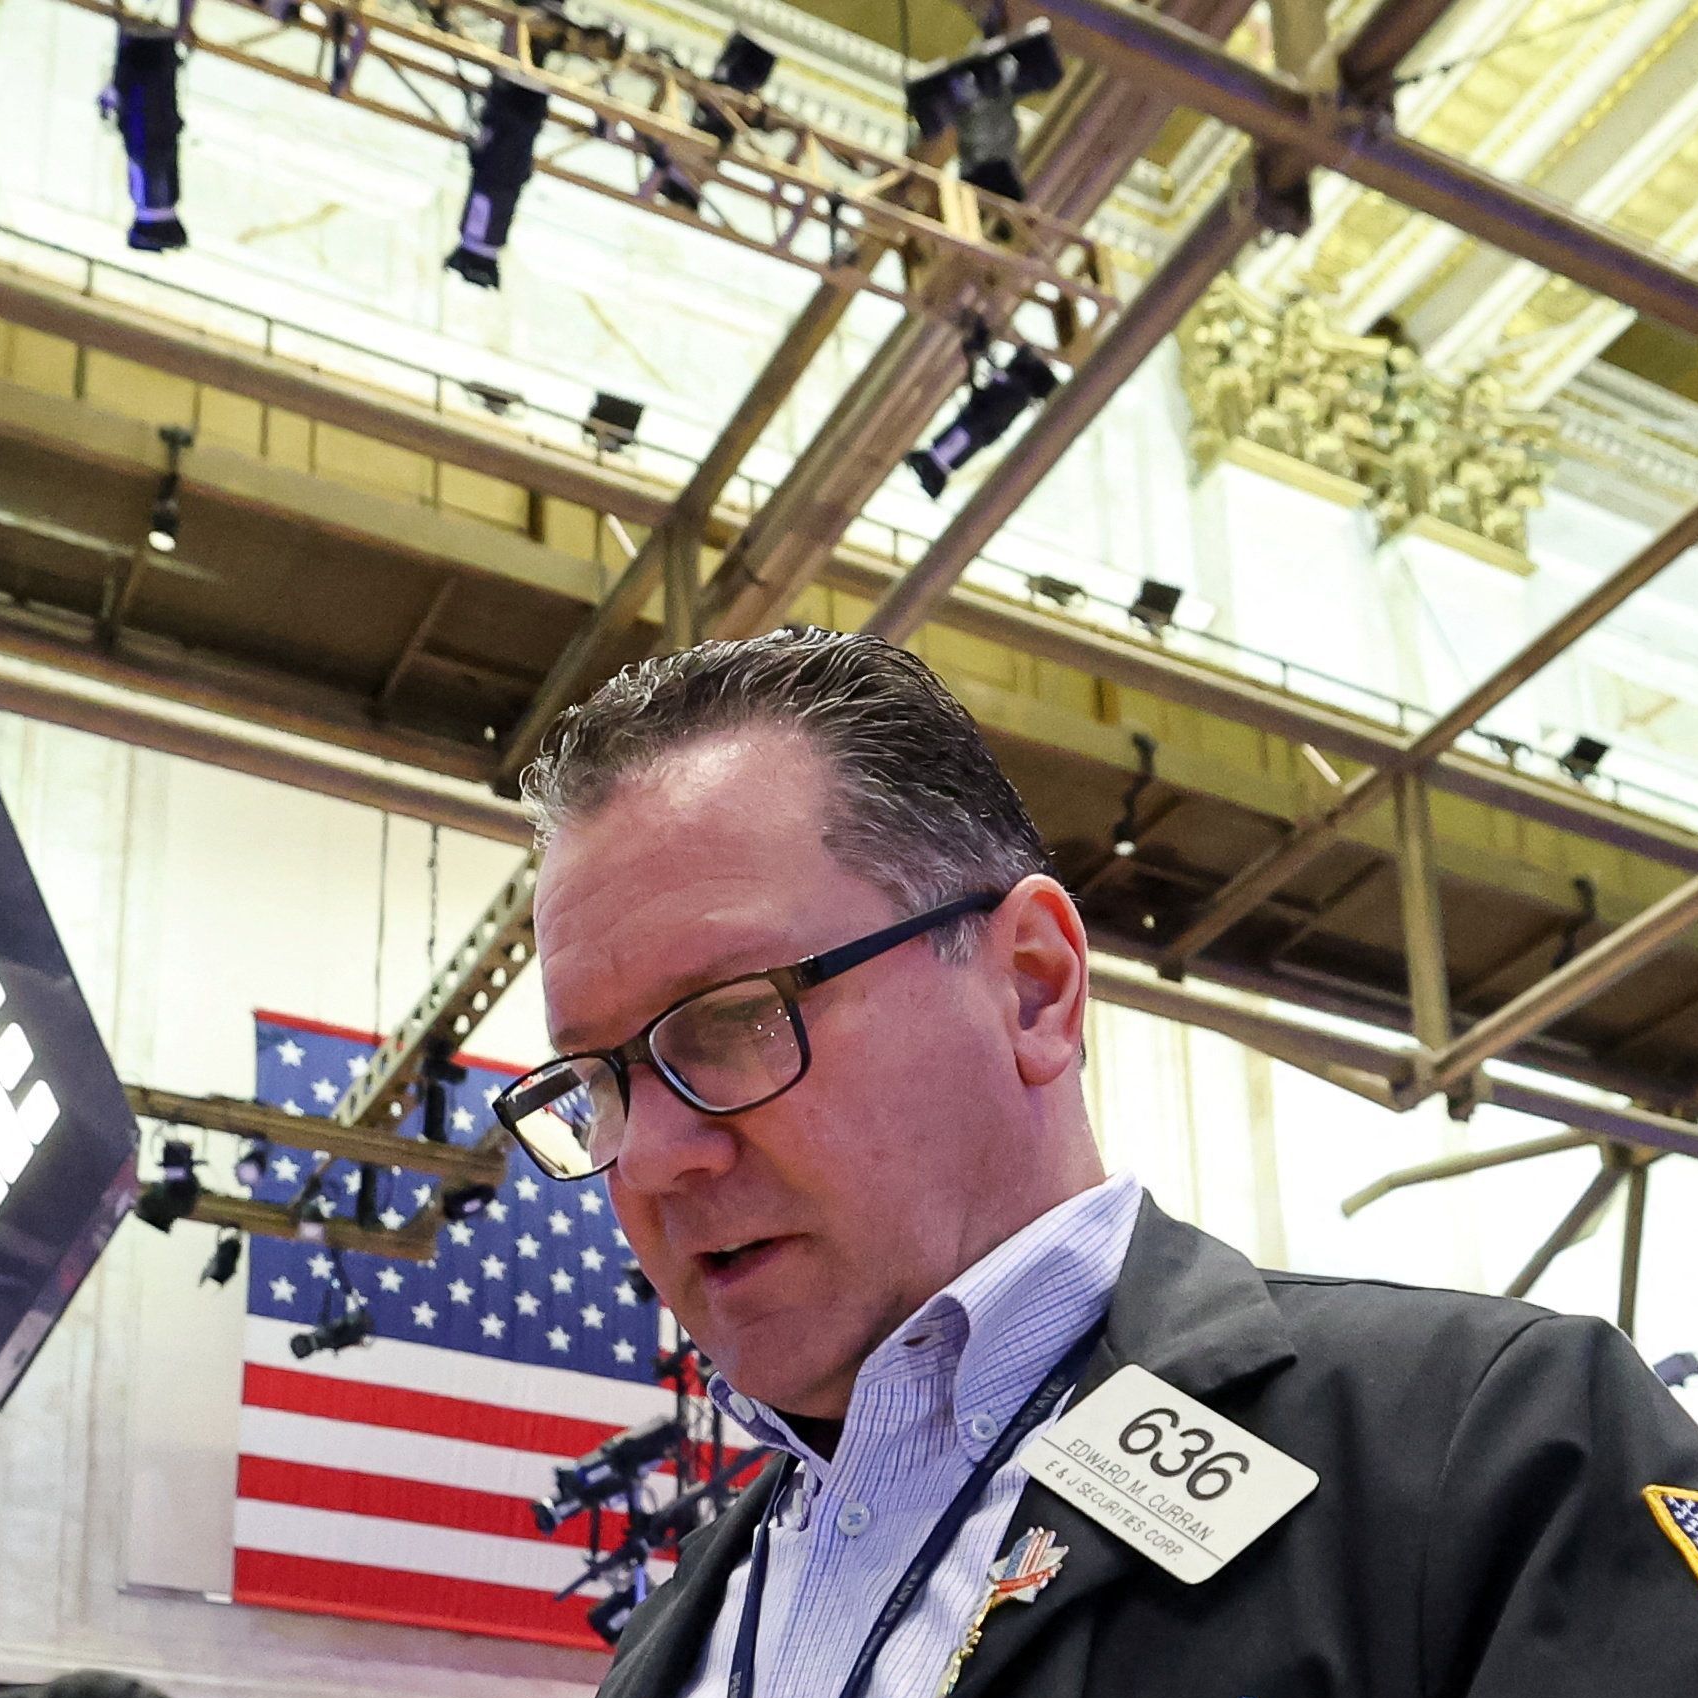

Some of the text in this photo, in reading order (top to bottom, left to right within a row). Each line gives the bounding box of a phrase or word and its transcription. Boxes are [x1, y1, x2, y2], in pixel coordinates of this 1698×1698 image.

[1066, 1438, 1131, 1487] EDWARD
[1148, 1493, 1216, 1543] CURRAN
[1117, 1407, 1250, 1502] 636
[1044, 1459, 1057, 1473] E
[1075, 1480, 1145, 1533] SECURITIES
[1144, 1527, 1184, 1562] CORP.
